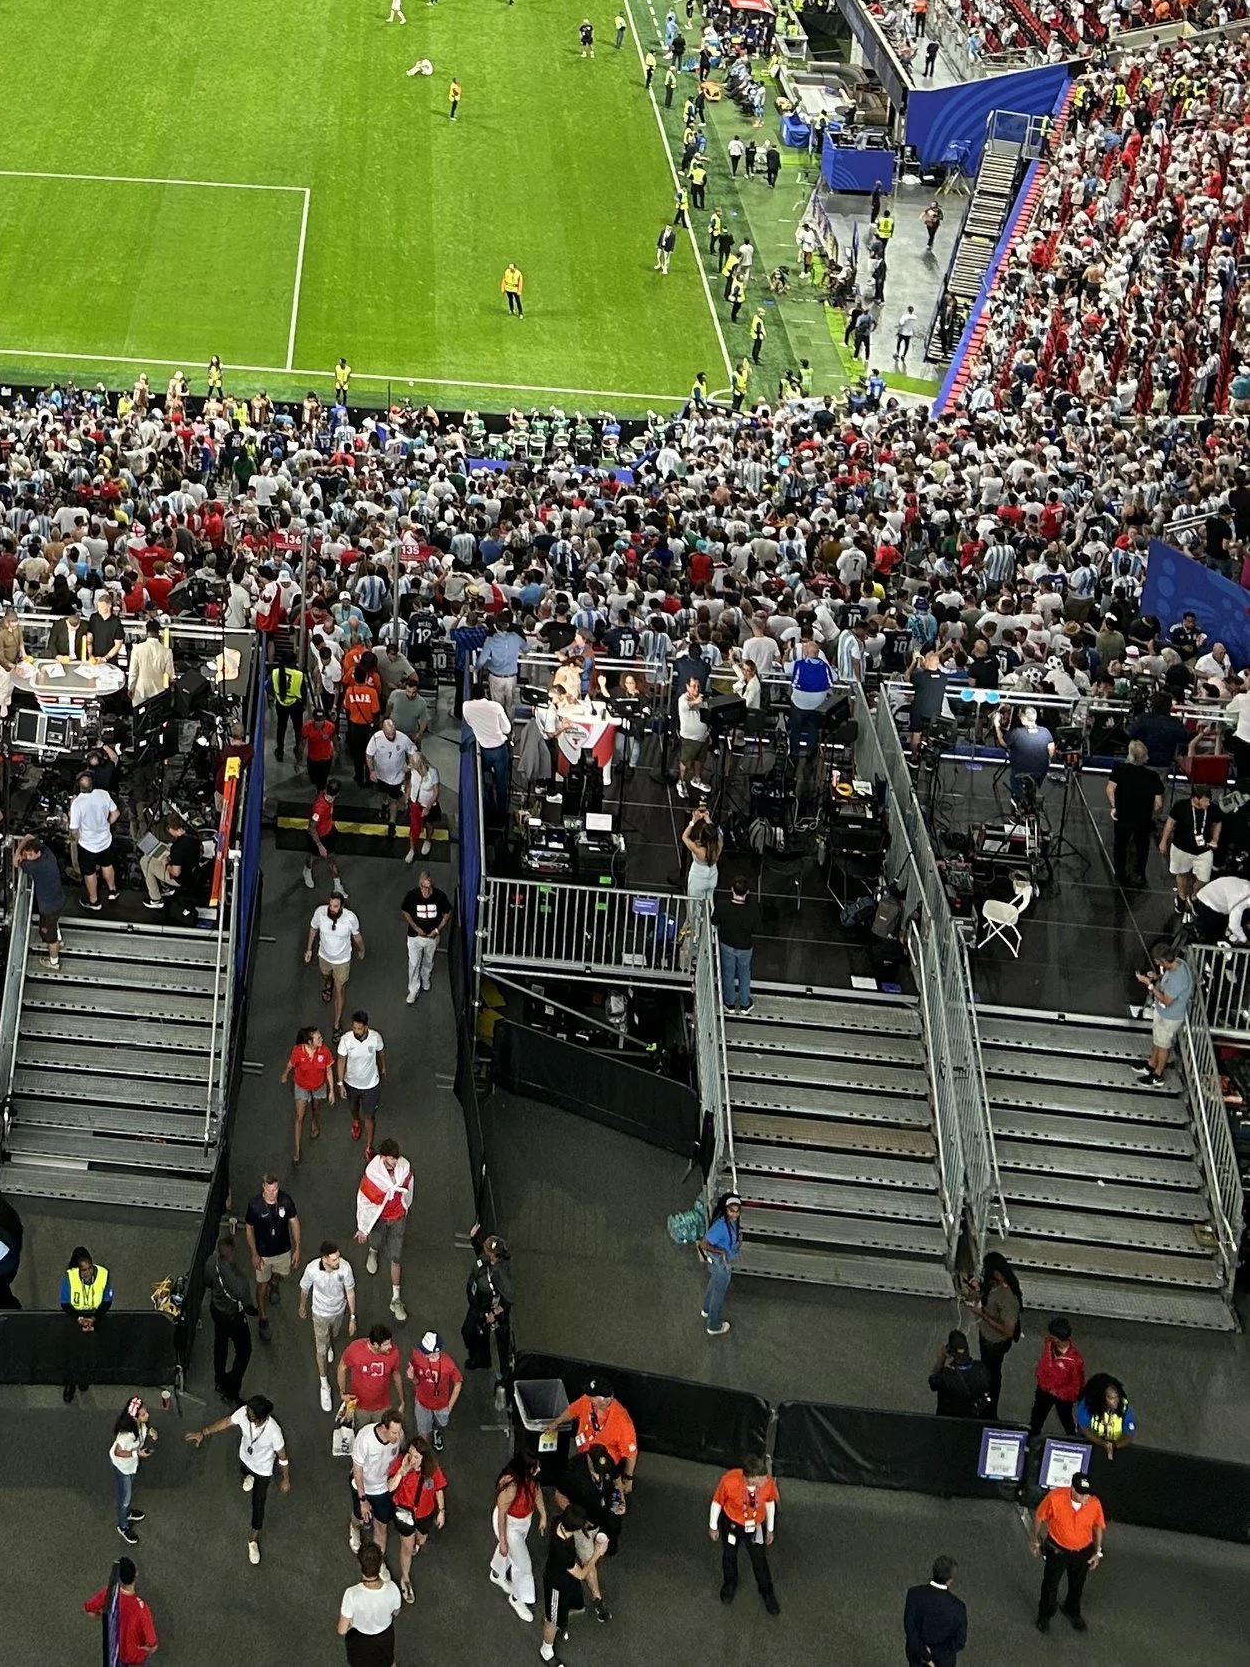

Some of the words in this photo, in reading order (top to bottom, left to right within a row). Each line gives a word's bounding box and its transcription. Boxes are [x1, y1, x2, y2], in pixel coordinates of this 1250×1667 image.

[284, 533, 302, 545] 136
[401, 545, 420, 555] 135
[853, 558, 860, 570] 7
[821, 586, 831, 600] 6
[415, 627, 432, 644] 19
[619, 639, 635, 657] 10
[894, 640, 908, 653] 10
[432, 653, 447, 669] 10
